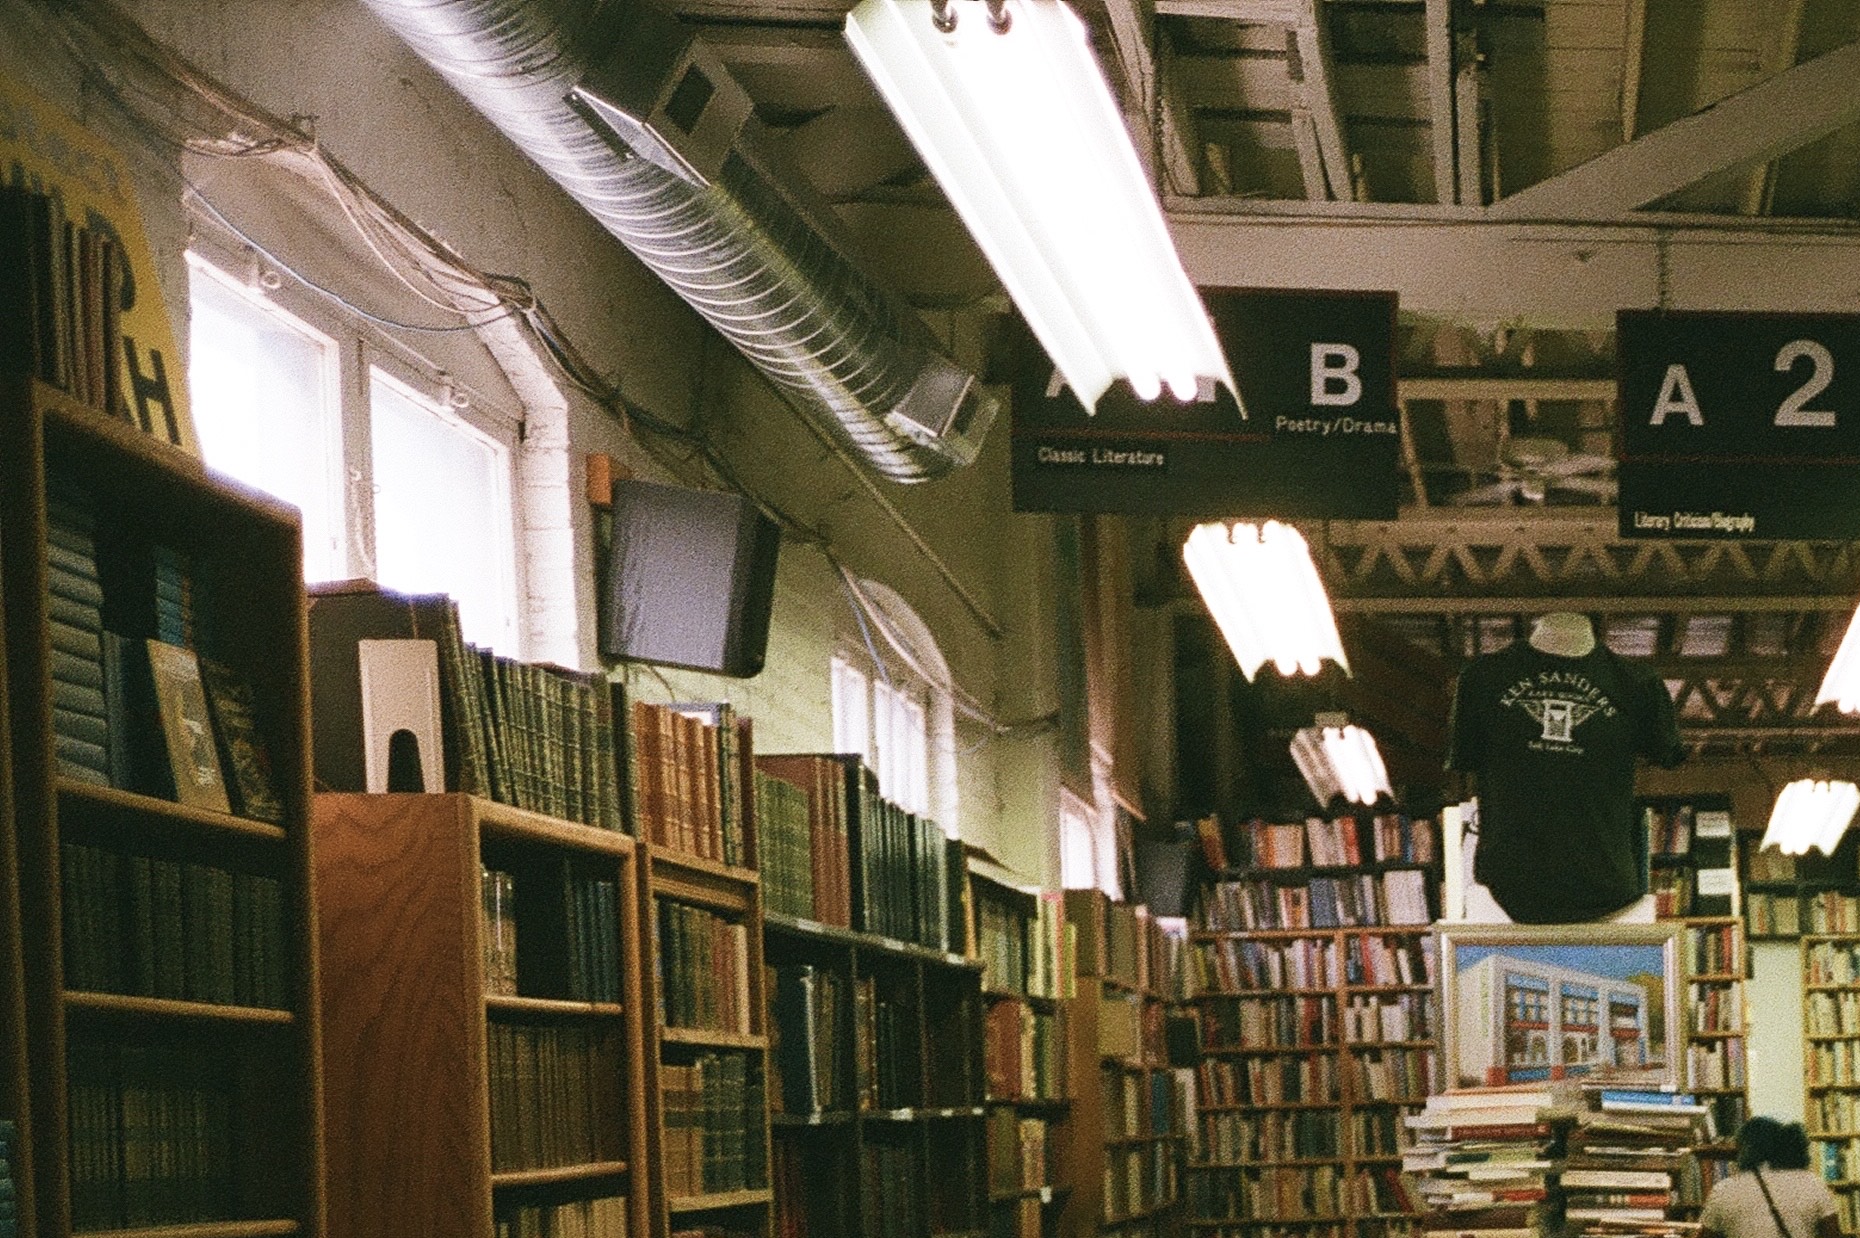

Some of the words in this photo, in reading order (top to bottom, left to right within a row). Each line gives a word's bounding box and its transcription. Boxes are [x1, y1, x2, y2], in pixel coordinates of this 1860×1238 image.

[1310, 342, 1362, 406] B
[1648, 363, 1704, 426] A
[1773, 339, 1837, 427] 2
[1275, 414, 1398, 437] Poetry/Drama
[1038, 447, 1086, 464] Classic
[1092, 448, 1165, 467] Literature
[1500, 677, 1533, 707] KEN
[1539, 671, 1617, 718] SANDERS
